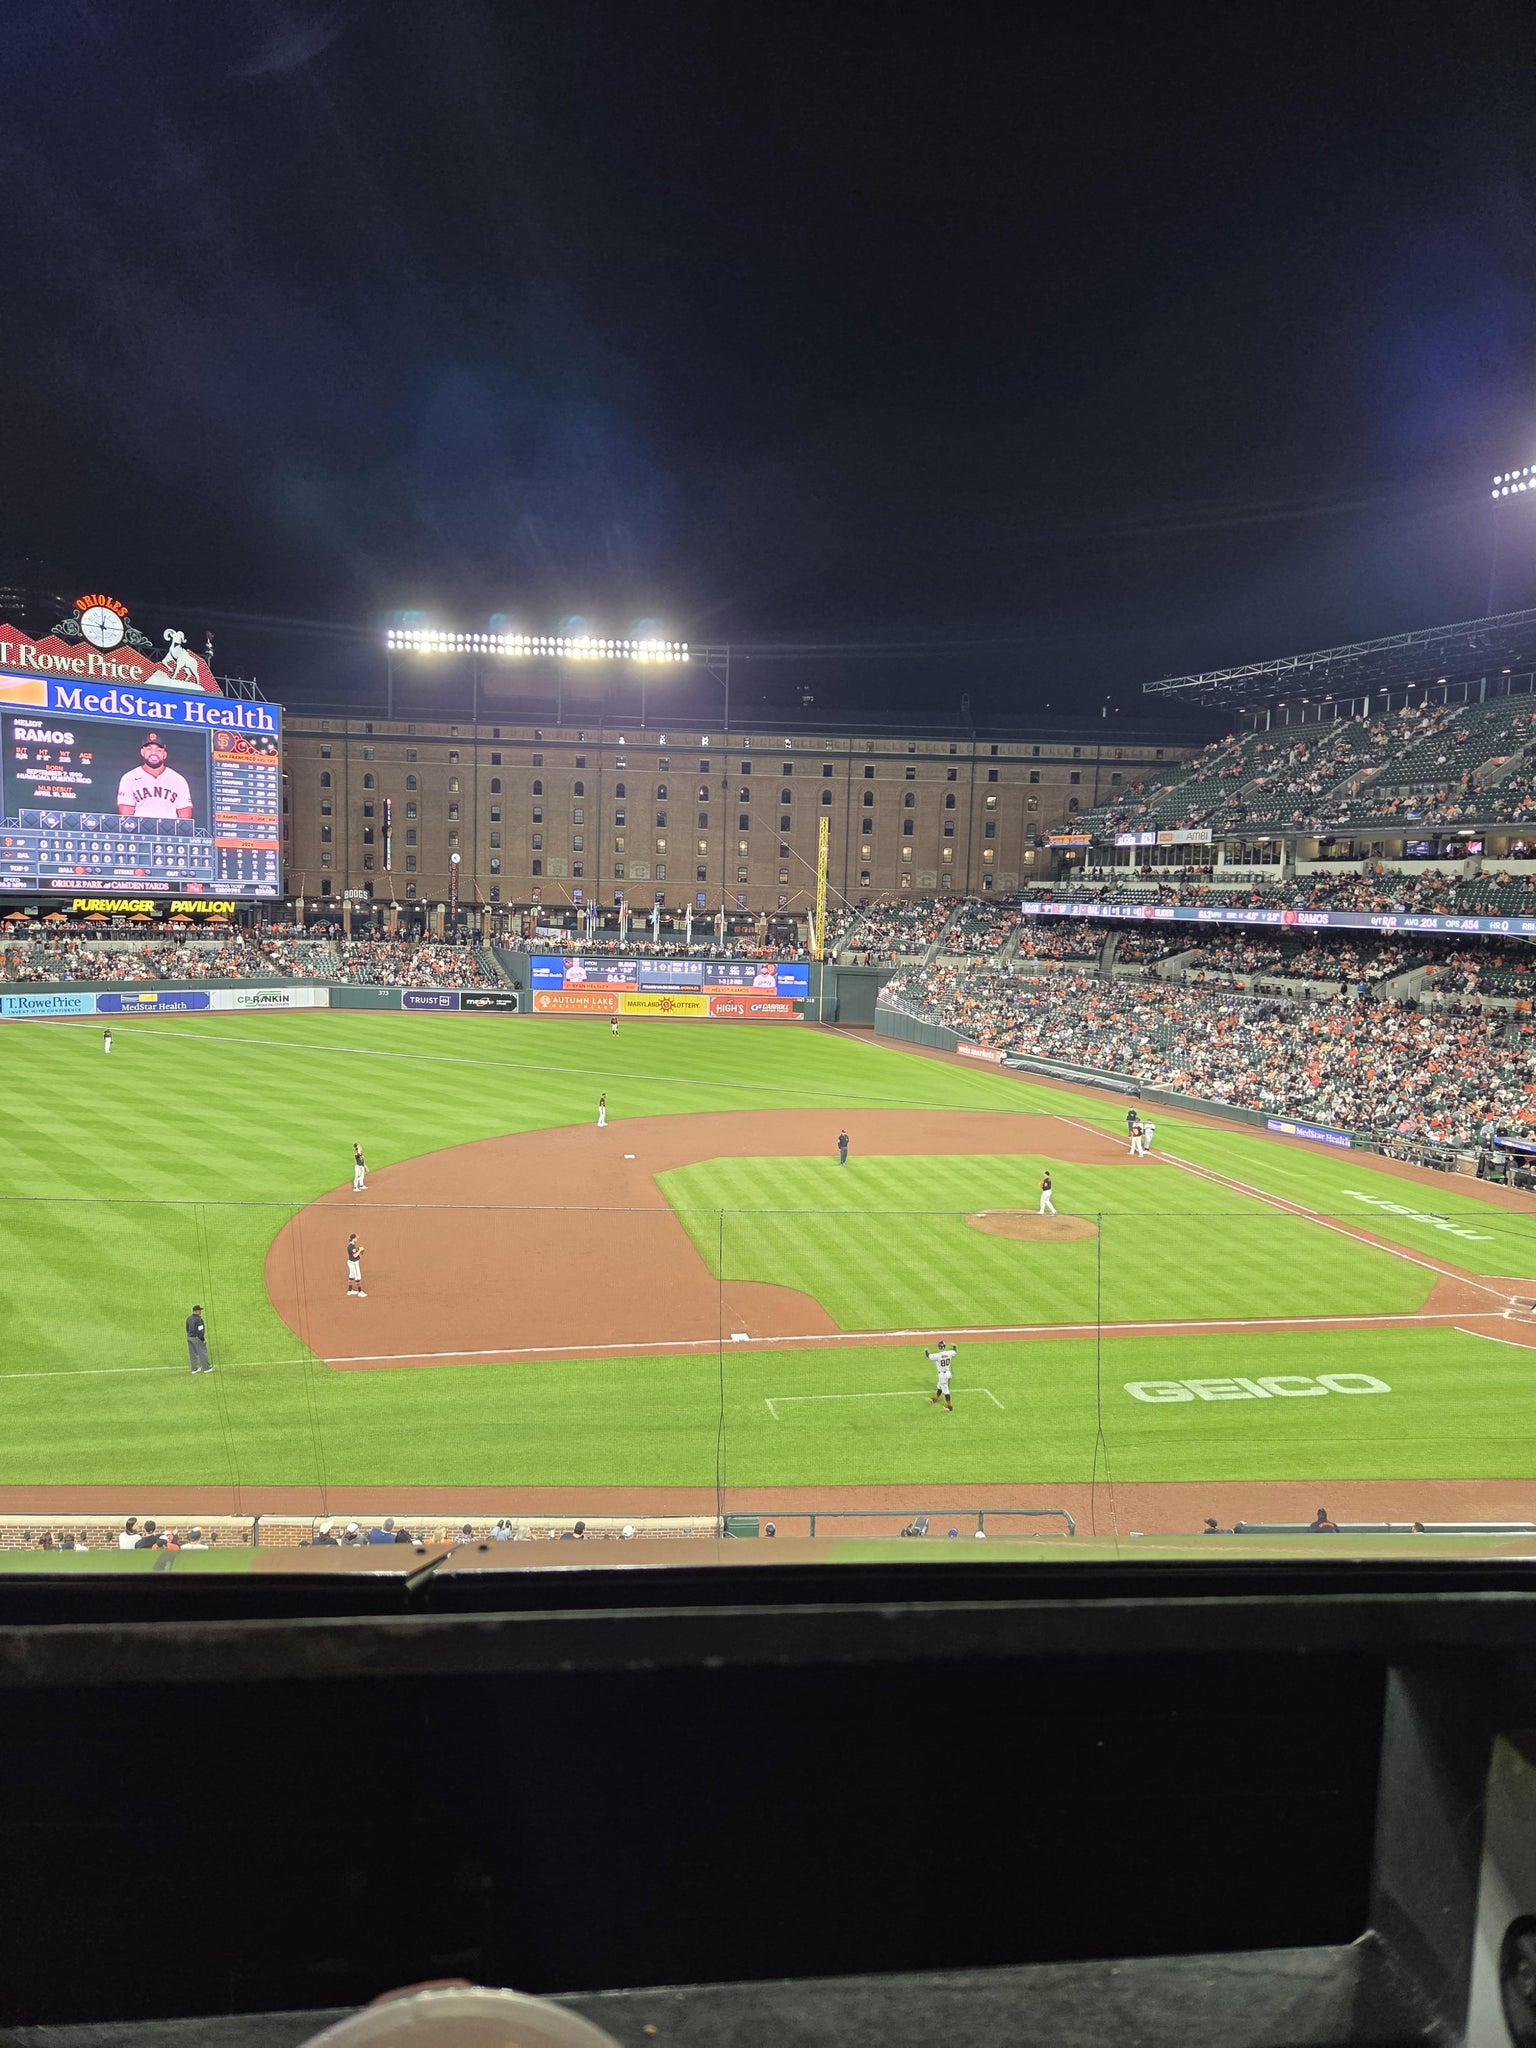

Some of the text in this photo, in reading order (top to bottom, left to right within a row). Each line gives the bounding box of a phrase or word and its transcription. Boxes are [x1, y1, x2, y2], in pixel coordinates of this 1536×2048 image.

[76, 594, 128, 617] ORIOLES
[55, 686, 275, 730] MedStar Health
[14, 719, 43, 727] HELIOT
[15, 728, 75, 745] RAMOS
[1186, 831, 1208, 841] AMBI
[40, 840, 48, 848] 0
[65, 841, 73, 849] 0
[80, 842, 85, 850] 1
[91, 842, 99, 850] 0
[104, 843, 111, 851] 0
[129, 844, 136, 852] 0
[155, 845, 162, 853] 2
[178, 846, 185, 854] 0
[41, 852, 48, 861] 0
[54, 853, 59, 861] 1
[80, 854, 87, 862] 2
[91, 854, 99, 862] 0
[103, 855, 111, 863] 0
[119, 856, 123, 864] 1
[155, 857, 162, 865] 6
[178, 858, 185, 866] 0
[51, 880, 83, 888] ORIOLE
[111, 881, 144, 889] CAMDEN
[144, 882, 169, 890] YARDS
[72, 898, 236, 912] PUREWAGER PAVILION
[1298, 913, 1329, 924] RAMOS
[1382, 916, 1397, 927] R/R
[1419, 918, 1437, 928] .204
[1445, 920, 1460, 928] OPS
[1501, 921, 1509, 931] 0
[1522, 923, 1535, 931] RBI
[607, 974, 626, 982] 86.2
[410, 996, 439, 1004] TRUIST
[552, 996, 614, 1005] AUTUMN LAKE
[121, 1002, 187, 1011] MedStar Health
[716, 1004, 744, 1014] HIGH'S
[1296, 1128, 1351, 1147] MedStar Health
[941, 1358, 950, 1367] 80
[1123, 1373, 1392, 1402] GEICO
